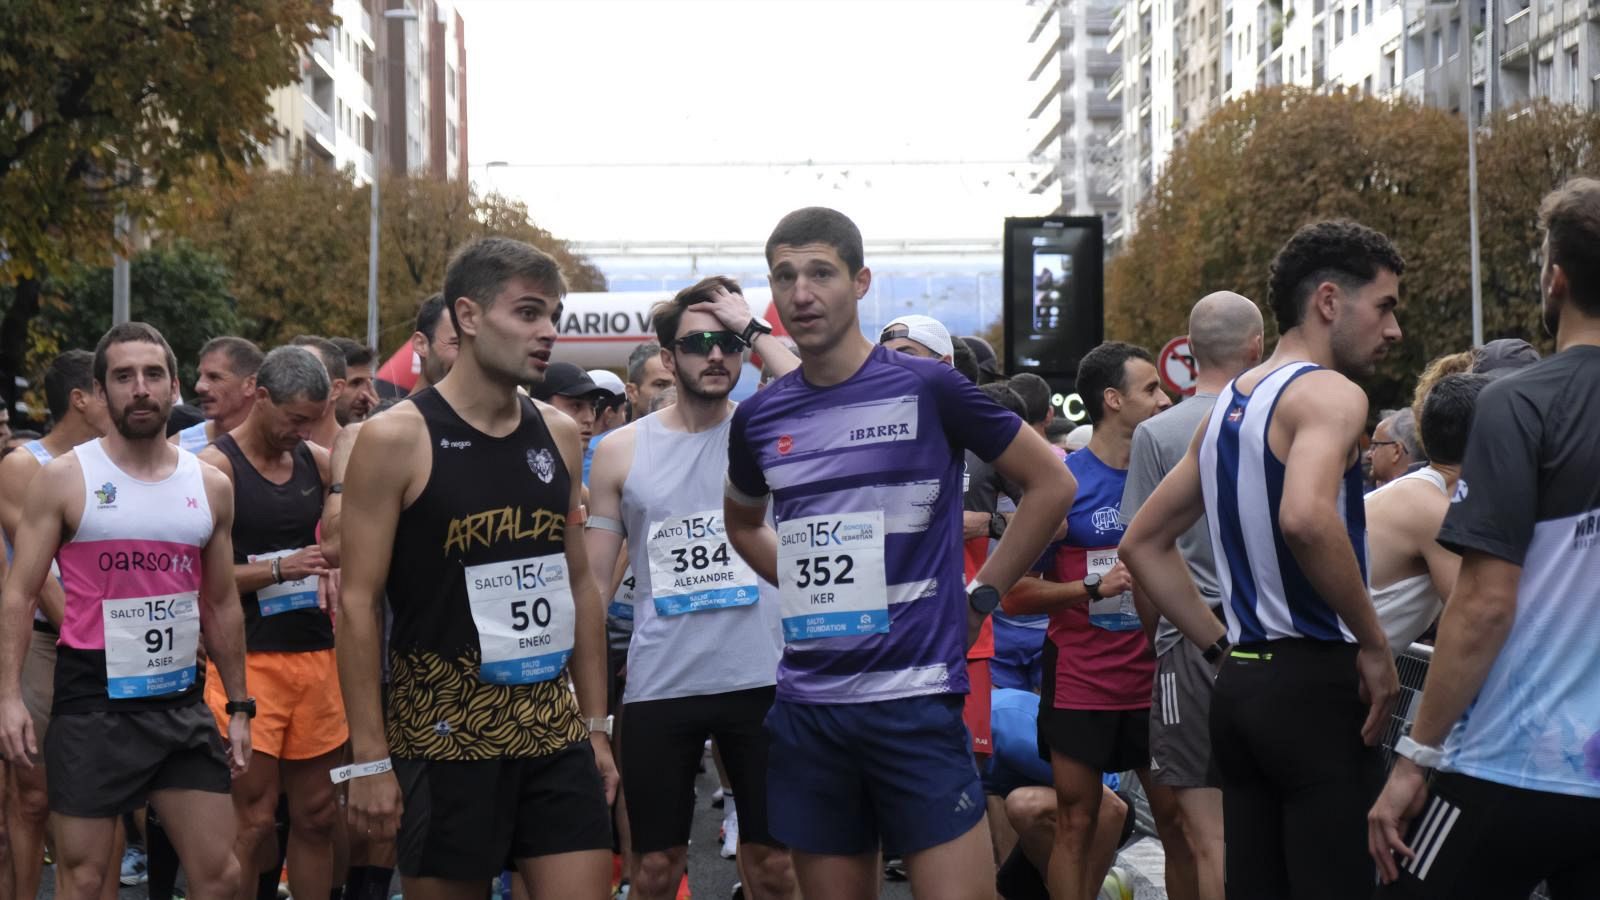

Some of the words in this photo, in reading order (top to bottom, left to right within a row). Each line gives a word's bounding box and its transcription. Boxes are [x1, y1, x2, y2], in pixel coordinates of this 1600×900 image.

[782, 532, 806, 546] SALTO
[671, 543, 730, 573] 384
[796, 555, 854, 588] 352
[475, 575, 512, 590] SALTO
[674, 572, 734, 587] ALEXANDRE
[810, 593, 834, 604] IKER
[110, 608, 145, 618] SALTO
[511, 597, 551, 631] 50
[806, 617, 824, 625] SALTO
[806, 623, 846, 633] FOUNDATION
[145, 627, 173, 654] 91
[519, 634, 551, 648] ENEKO
[147, 657, 173, 667] ASIER
